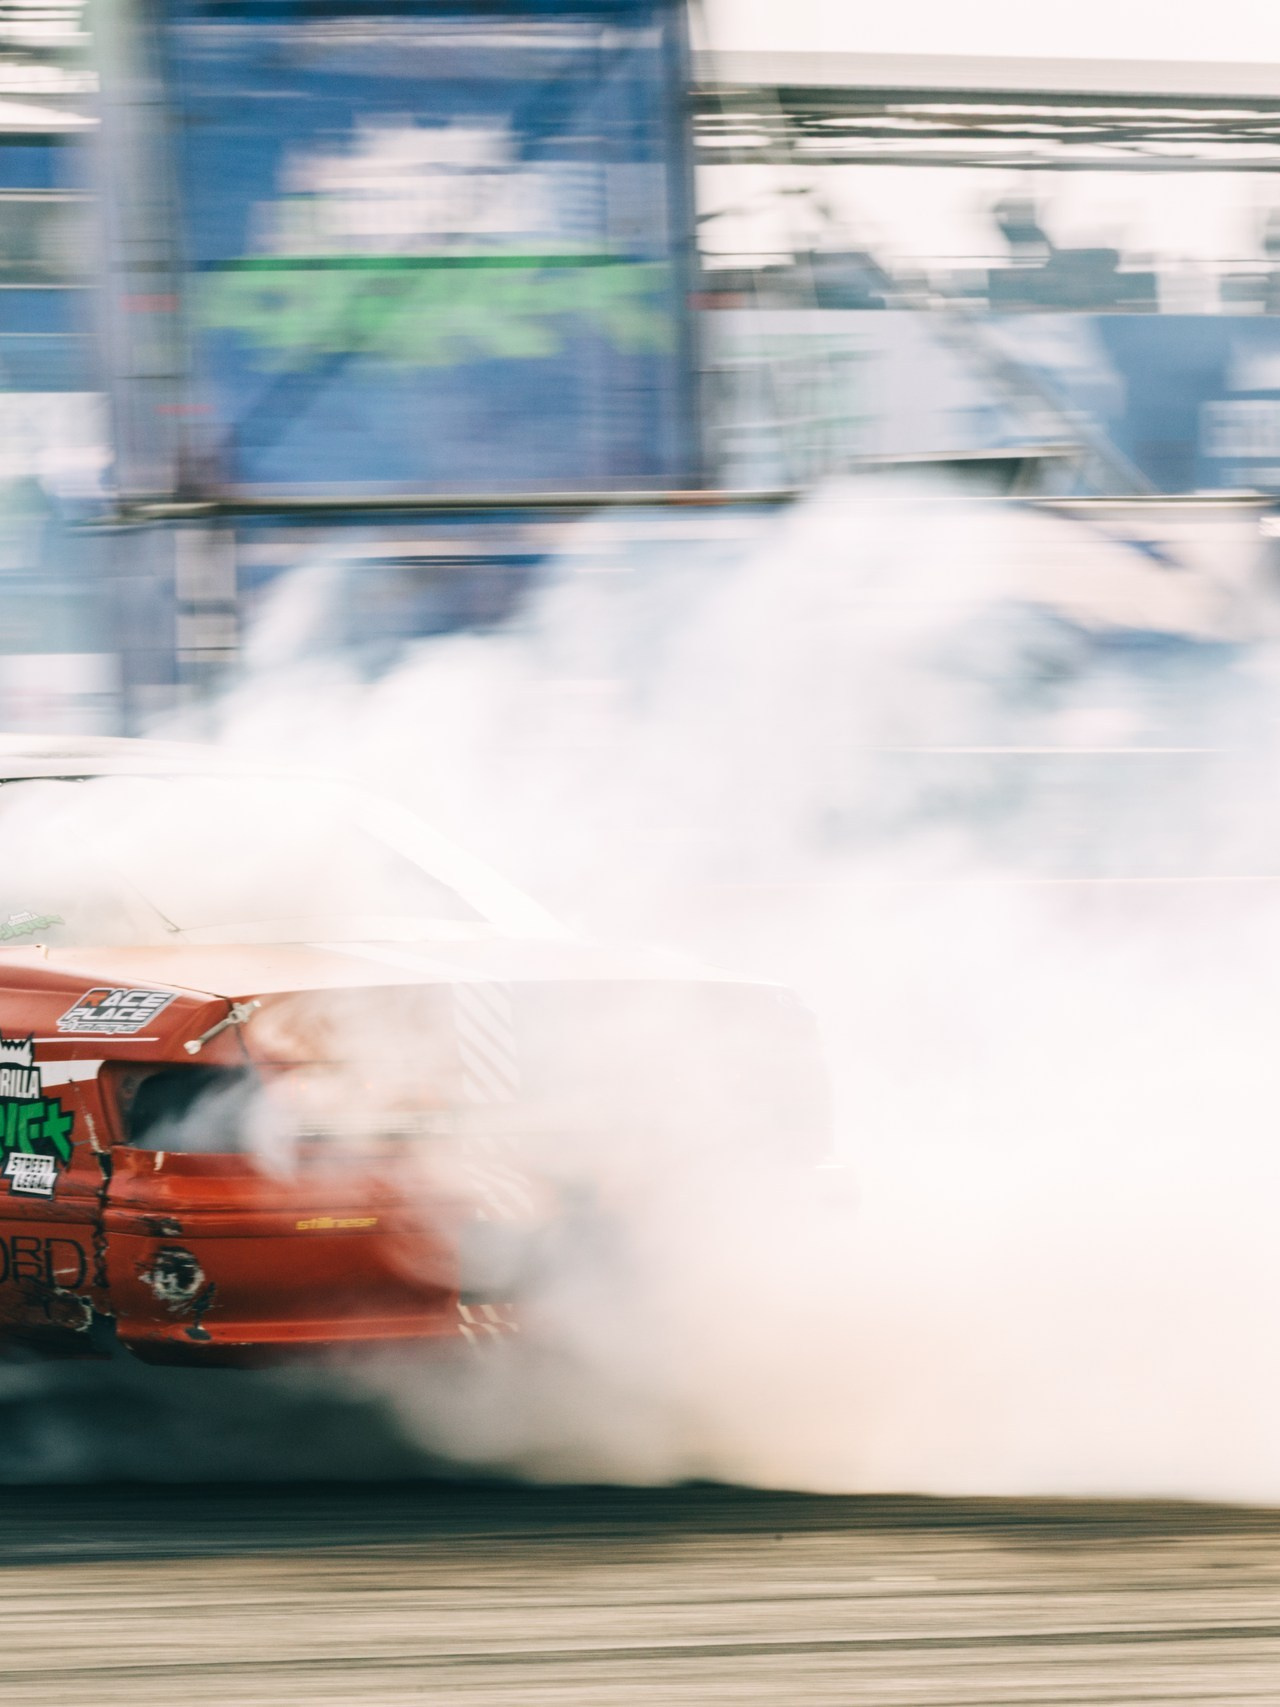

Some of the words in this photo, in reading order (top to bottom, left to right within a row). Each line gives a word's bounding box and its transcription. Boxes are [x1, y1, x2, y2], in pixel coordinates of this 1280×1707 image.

[80, 991, 173, 1007] RACE
[64, 1007, 154, 1020] PLACE
[9, 1155, 53, 1174] STREET
